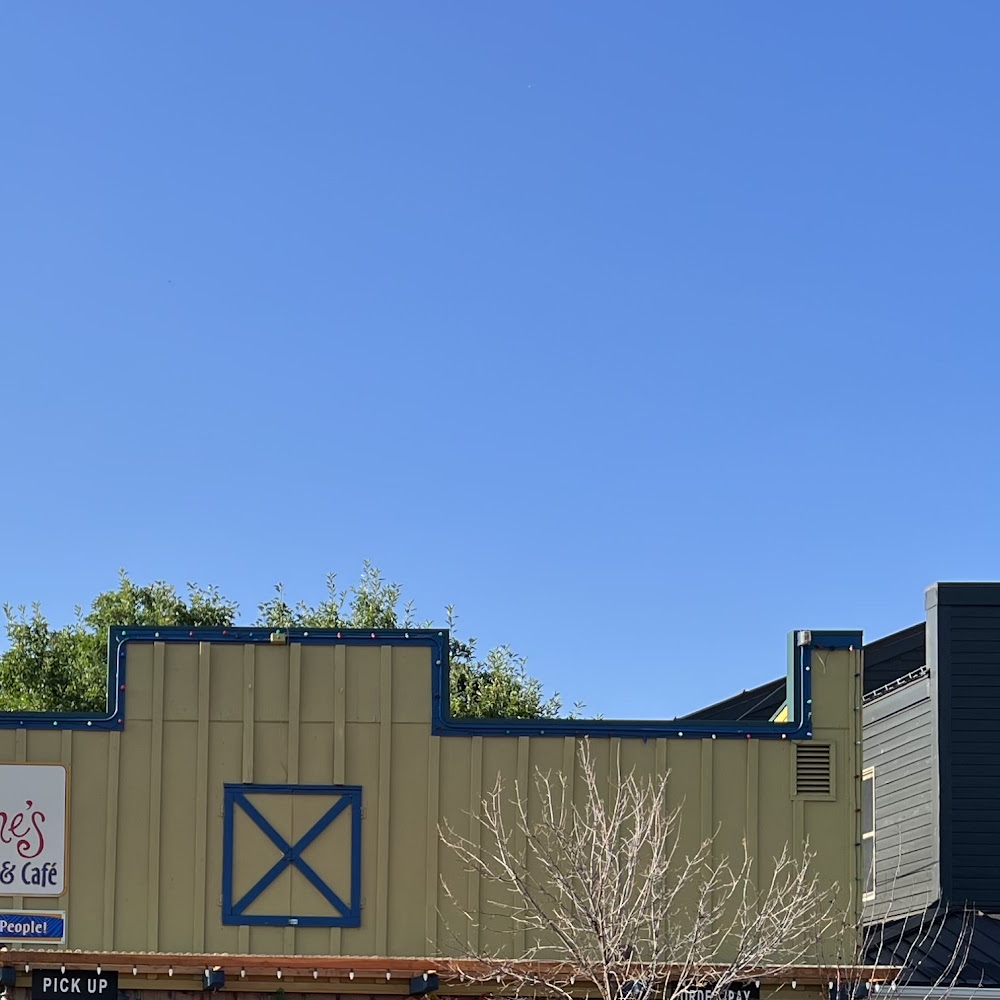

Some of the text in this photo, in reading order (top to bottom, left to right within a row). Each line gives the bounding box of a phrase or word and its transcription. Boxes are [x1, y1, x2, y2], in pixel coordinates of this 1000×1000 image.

[0, 861, 16, 884] &
[21, 861, 58, 887] Café
[0, 920, 47, 936] People!
[43, 977, 108, 993] PICK UP
